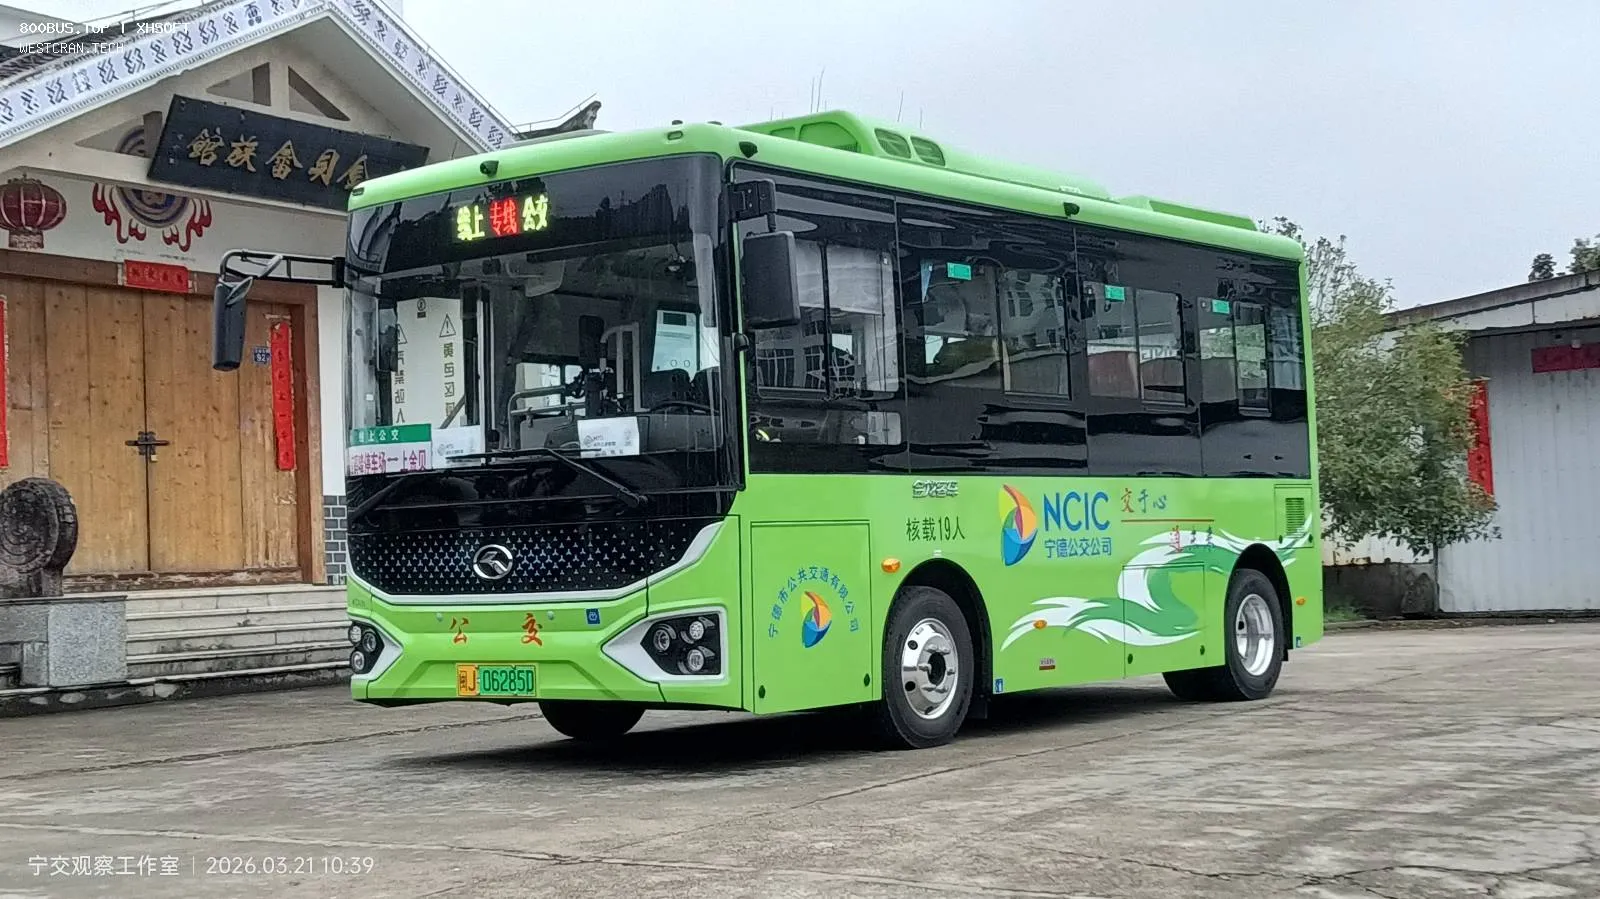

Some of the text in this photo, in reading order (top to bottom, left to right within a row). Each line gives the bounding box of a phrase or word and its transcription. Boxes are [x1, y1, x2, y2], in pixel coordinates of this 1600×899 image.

[1043, 491, 1111, 532] NCIC
[905, 515, 966, 541] 核载19人
[1044, 536, 1112, 559] 宁德公交公司
[767, 566, 860, 640] 宁德市公共交通有限公司
[482, 669, 534, 692] 06285D
